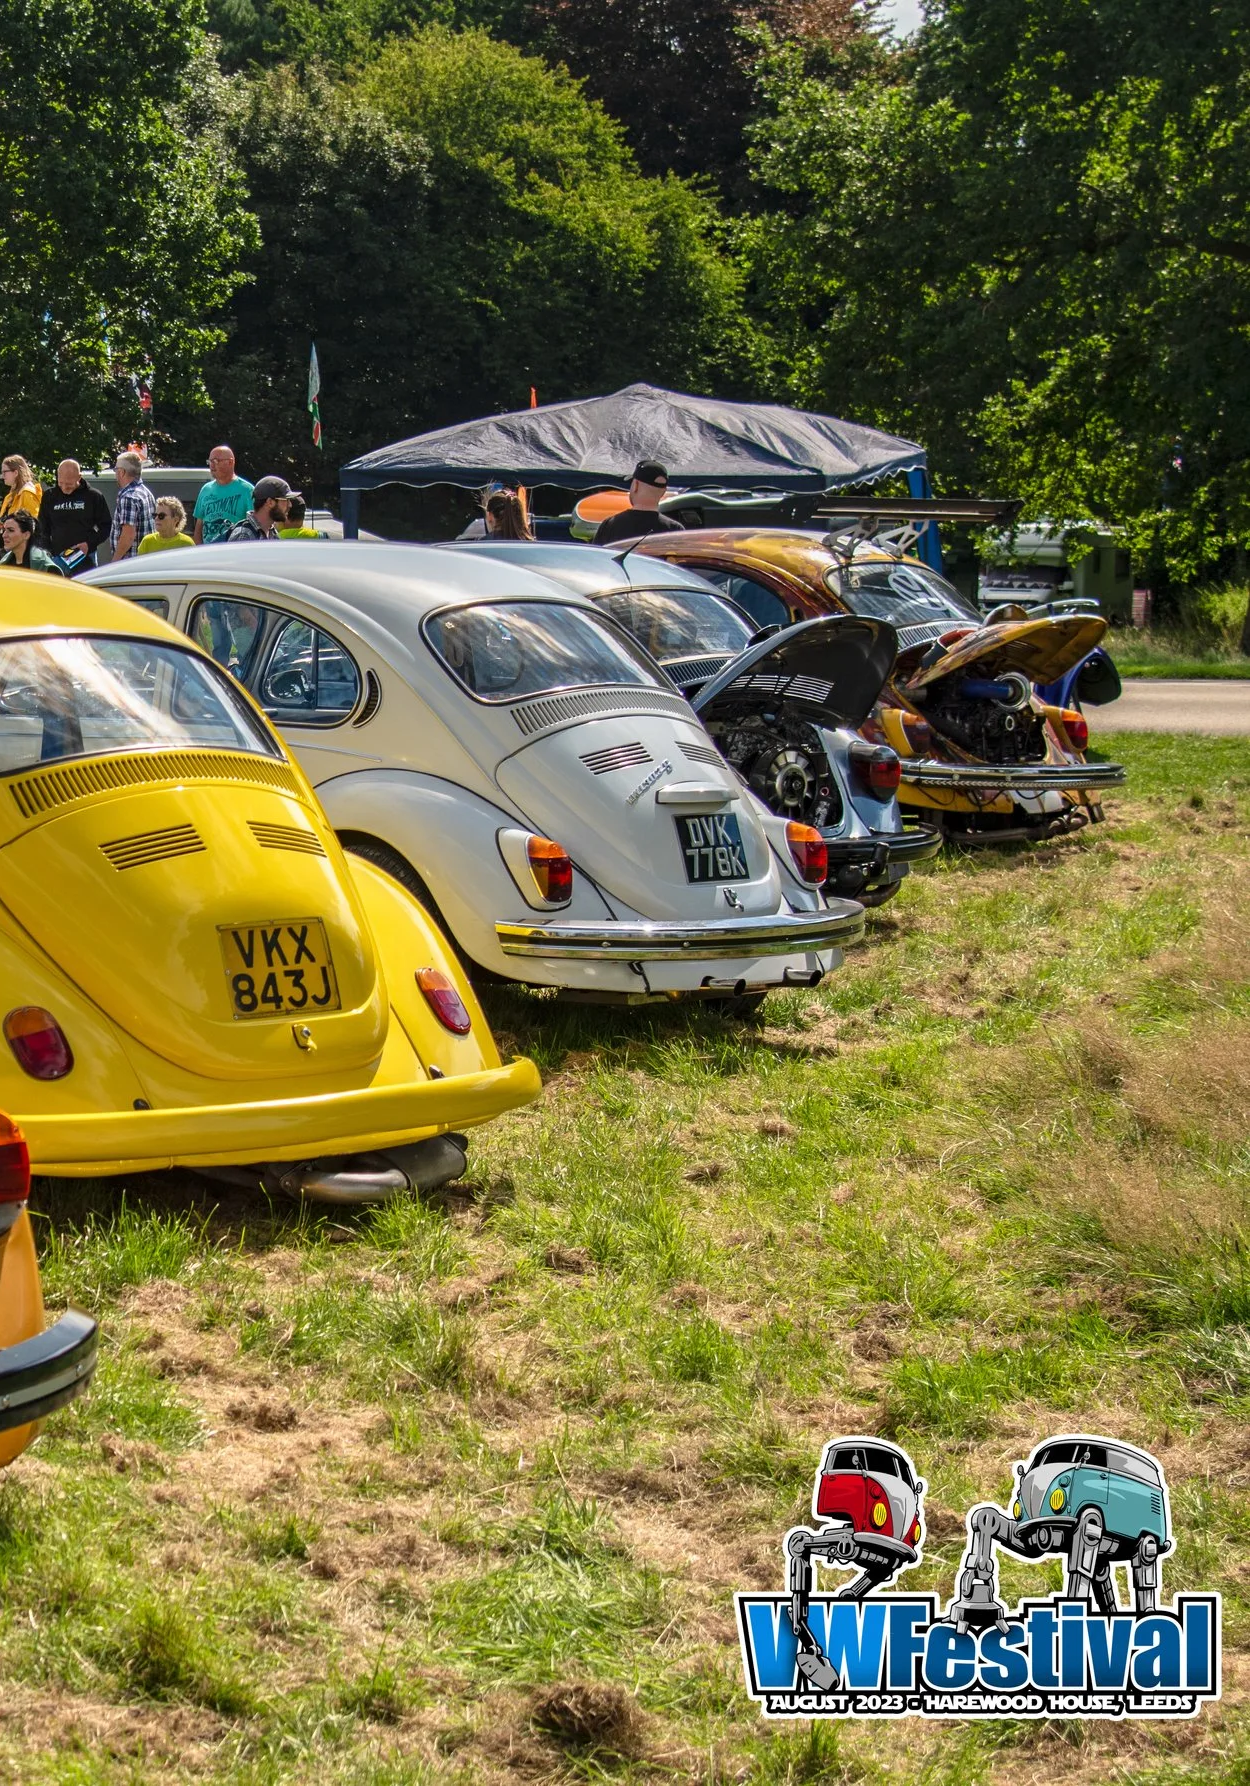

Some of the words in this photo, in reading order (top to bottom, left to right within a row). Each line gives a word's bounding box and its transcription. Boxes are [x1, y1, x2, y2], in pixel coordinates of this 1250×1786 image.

[685, 816, 732, 848] DVK
[685, 846, 746, 879] 778K
[231, 925, 317, 969] VKX
[232, 966, 332, 1012] 843J
